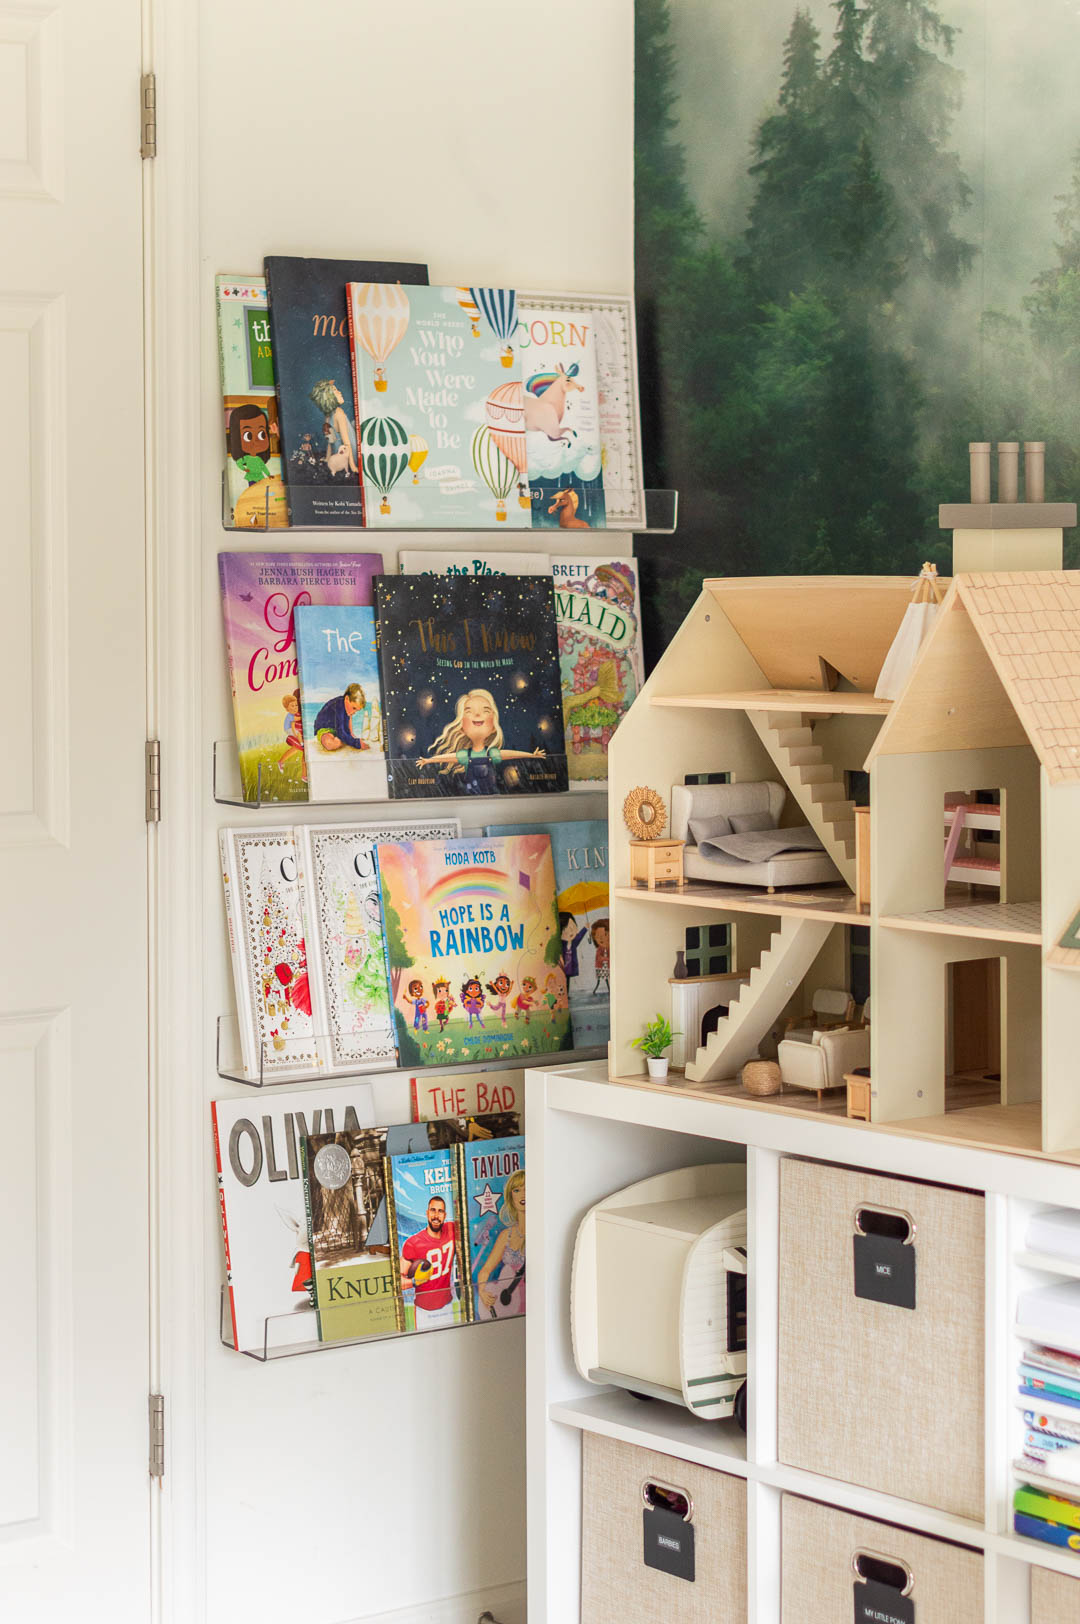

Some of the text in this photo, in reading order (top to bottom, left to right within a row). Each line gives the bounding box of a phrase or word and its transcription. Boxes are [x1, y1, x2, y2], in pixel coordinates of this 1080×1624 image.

[418, 330, 465, 358] Who
[518, 320, 590, 348] CORN
[409, 346, 447, 368] You
[425, 369, 476, 390] Were
[406, 386, 460, 414] Made
[436, 431, 461, 449] Be
[258, 577, 356, 586] BARBARA PIERCE BUSH
[260, 568, 288, 577] JENNA
[290, 567, 314, 577] BUSH
[316, 567, 346, 577] HAGER
[446, 564, 469, 576] the
[552, 564, 590, 577] BRETT
[553, 592, 626, 641] MAID
[321, 628, 363, 654] The
[409, 616, 457, 653] This
[463, 618, 472, 656] I
[481, 623, 536, 653] Know
[444, 848, 496, 866] HODA KOTB
[567, 846, 608, 870] KIN
[439, 903, 510, 928] HOPE IS A
[429, 923, 524, 957] RAINBOW
[427, 1087, 467, 1116] THE
[477, 1083, 515, 1113] BAD
[424, 1166, 451, 1185] KEL
[471, 1152, 520, 1180] TAYLOR
[426, 1240, 454, 1280] 87
[876, 1265, 891, 1276] MICE
[658, 1536, 680, 1550] BARBIES
[864, 1608, 873, 1618] MY
[874, 1612, 889, 1623] LITTLE
